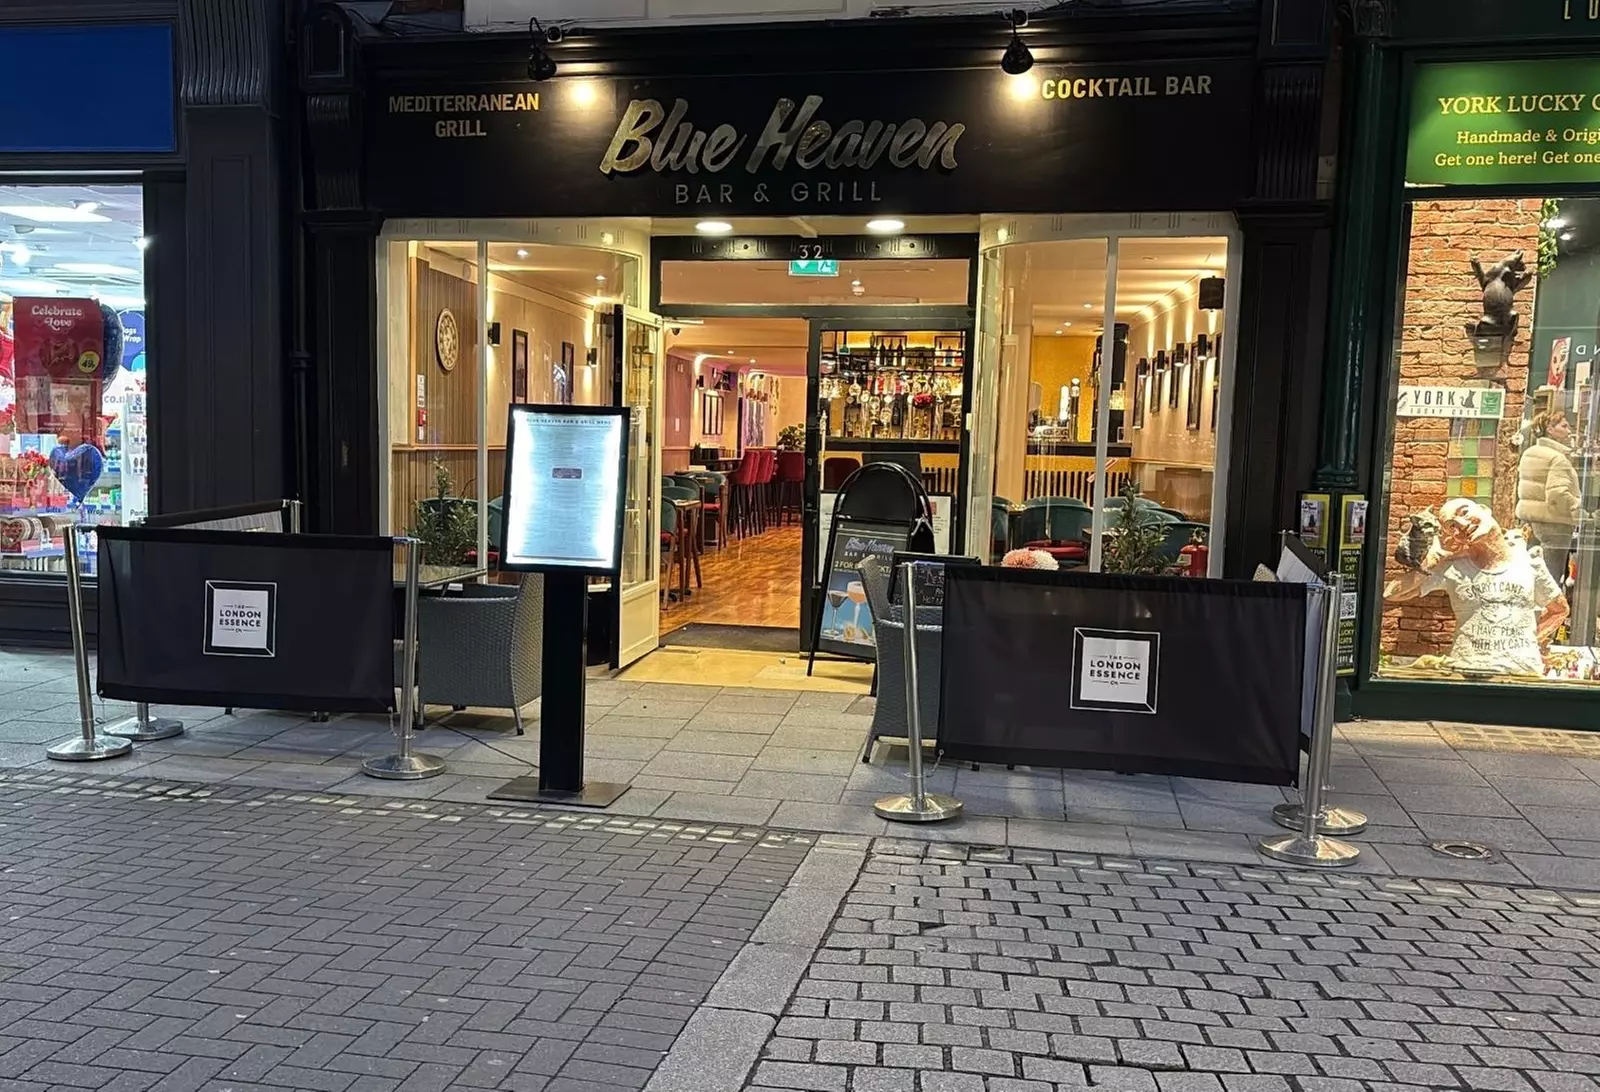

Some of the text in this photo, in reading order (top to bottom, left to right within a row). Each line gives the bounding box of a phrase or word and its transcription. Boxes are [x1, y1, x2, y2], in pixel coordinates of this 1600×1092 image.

[1042, 75, 1212, 99] COCKTAIL BAR
[389, 93, 539, 112] MEDITERRANEAN
[1438, 96, 1501, 114] YORK
[1507, 94, 1586, 113] LUCKY
[435, 120, 487, 137] GRILL
[600, 95, 965, 174] Blue Heaven
[1456, 129, 1540, 144] Handmade
[1545, 129, 1558, 142] &
[1434, 151, 1600, 166] Get one here! Get one
[676, 181, 881, 204] BAR & GRILL
[799, 244, 823, 259] 32
[31, 305, 83, 317] Celebrate
[44, 317, 73, 331] Love
[1414, 390, 1456, 406] YORK
[220, 610, 261, 618] LONDON
[219, 618, 261, 627] ESSENCE
[1090, 660, 1140, 670] LONDON
[1089, 669, 1140, 680] ESSENCE
